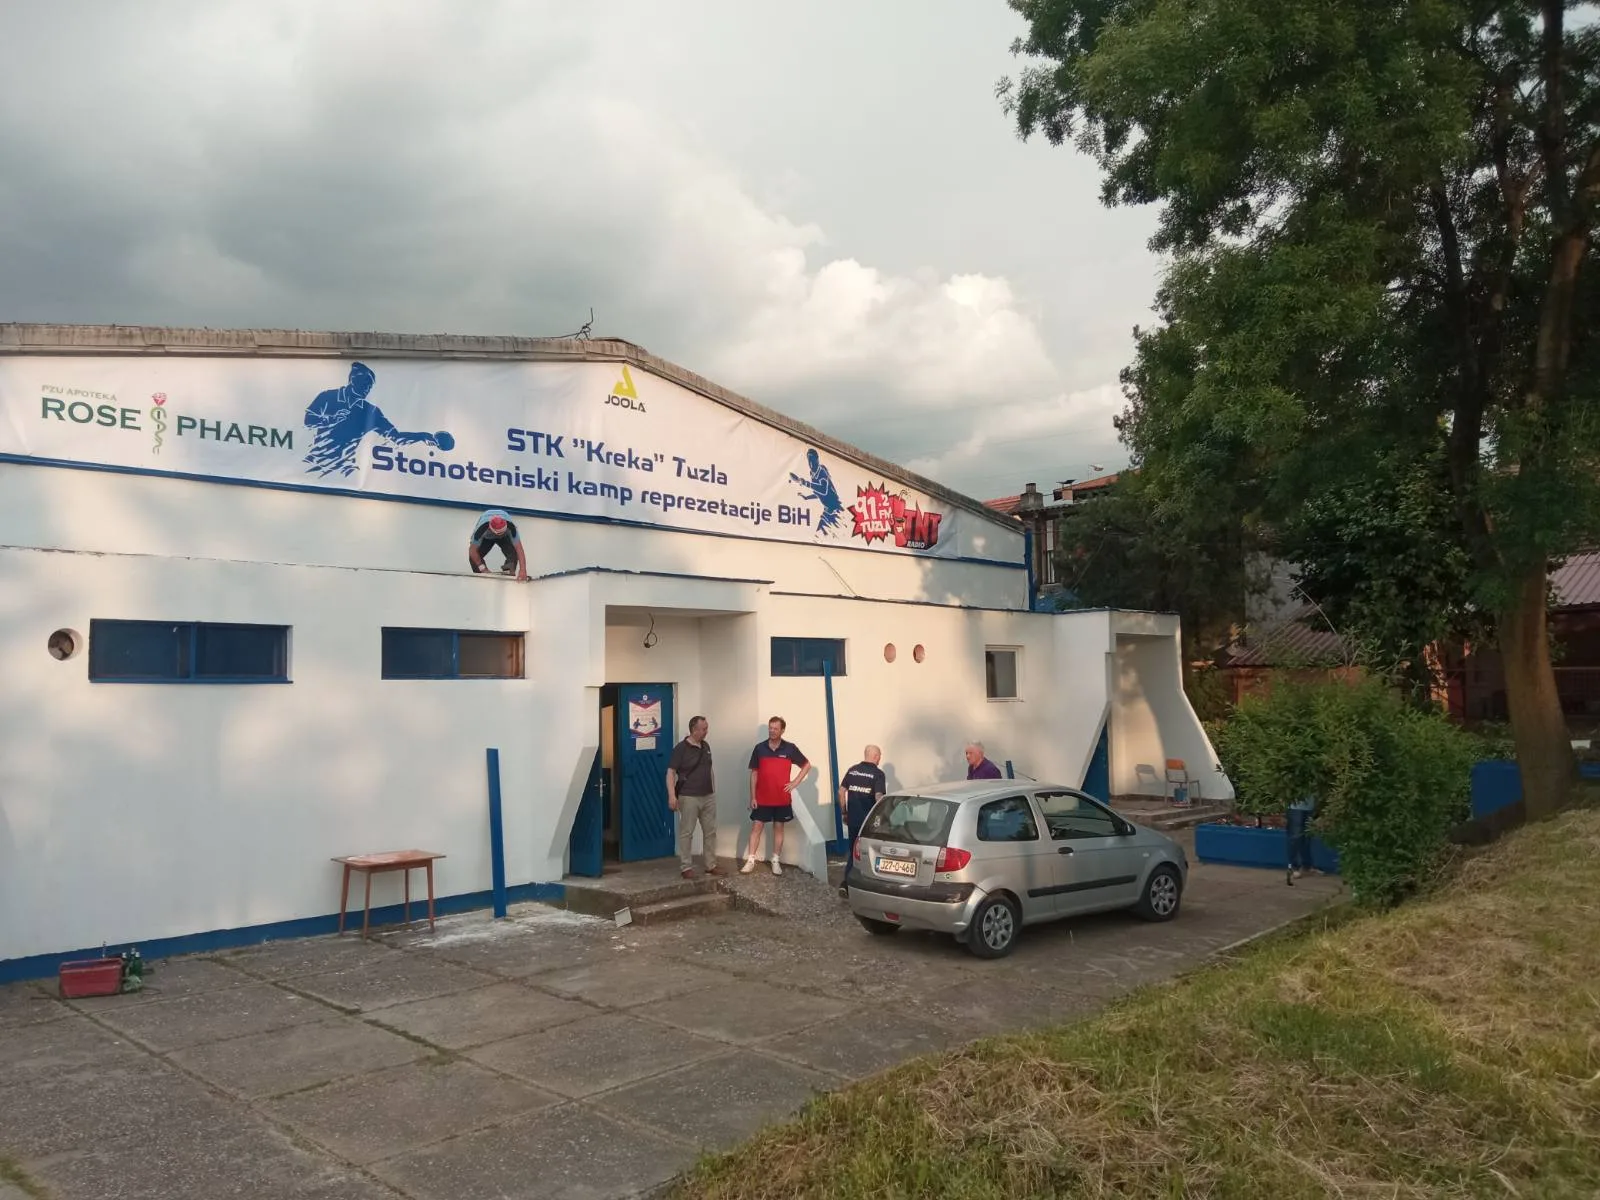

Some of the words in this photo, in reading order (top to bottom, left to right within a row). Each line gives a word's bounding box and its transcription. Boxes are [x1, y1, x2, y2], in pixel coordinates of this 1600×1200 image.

[41, 385, 64, 394] PZU
[66, 389, 117, 401] APOTEKA
[604, 394, 646, 412] JOOLA
[41, 397, 142, 431] ROSE
[176, 415, 294, 450] PHARM
[507, 428, 564, 458] STK
[672, 456, 728, 485] Tuzla
[372, 445, 559, 492] Stonoteniski
[567, 471, 633, 506] kamp
[641, 489, 772, 525] reprezetacije
[778, 504, 810, 526] BiH
[860, 520, 892, 533] TUZLA
[903, 499, 942, 545] TNT
[906, 540, 926, 548] RADIO
